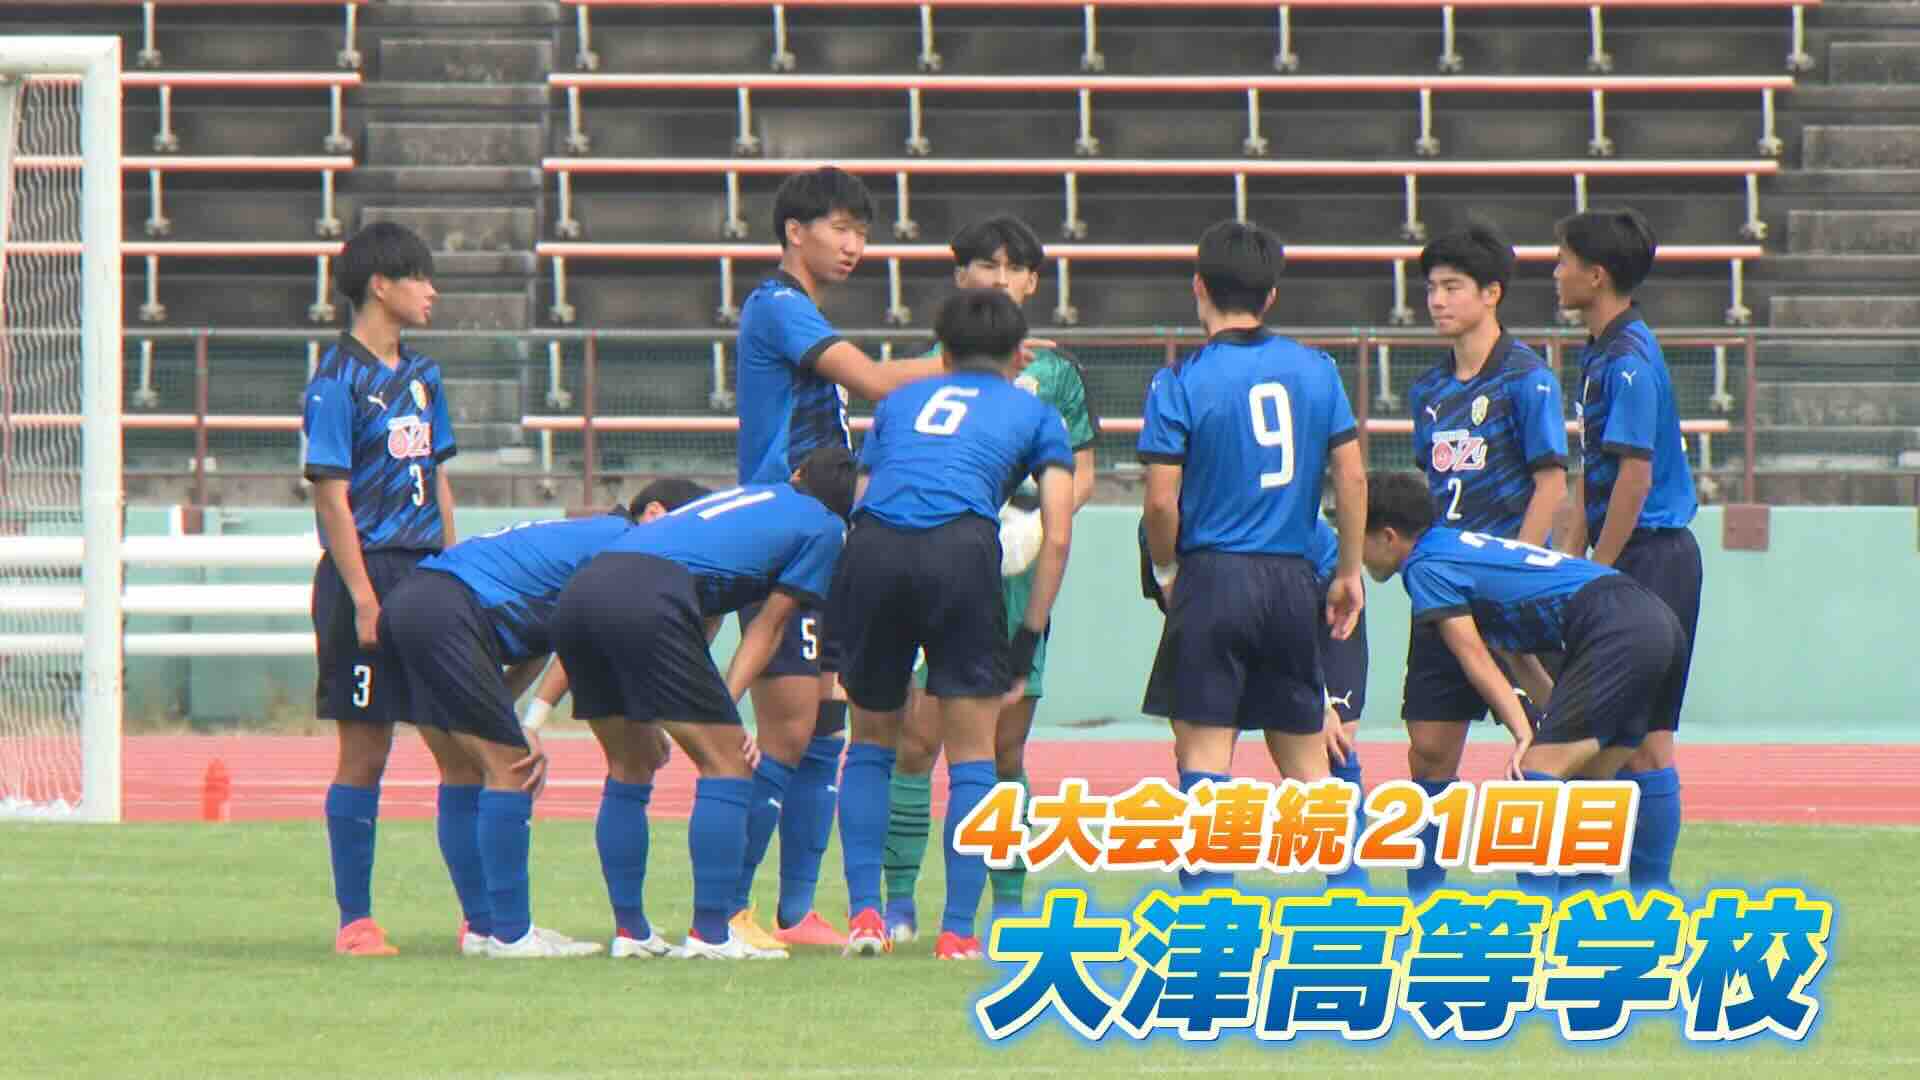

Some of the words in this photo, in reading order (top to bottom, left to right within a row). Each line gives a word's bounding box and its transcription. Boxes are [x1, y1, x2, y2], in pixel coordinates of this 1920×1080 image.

[914, 385, 979, 436] 6
[1249, 382, 1294, 489] 9
[409, 463, 425, 506] 3
[668, 487, 776, 519] 11
[1446, 478, 1463, 520] 2
[800, 618, 817, 660] 5
[352, 664, 371, 708] 3
